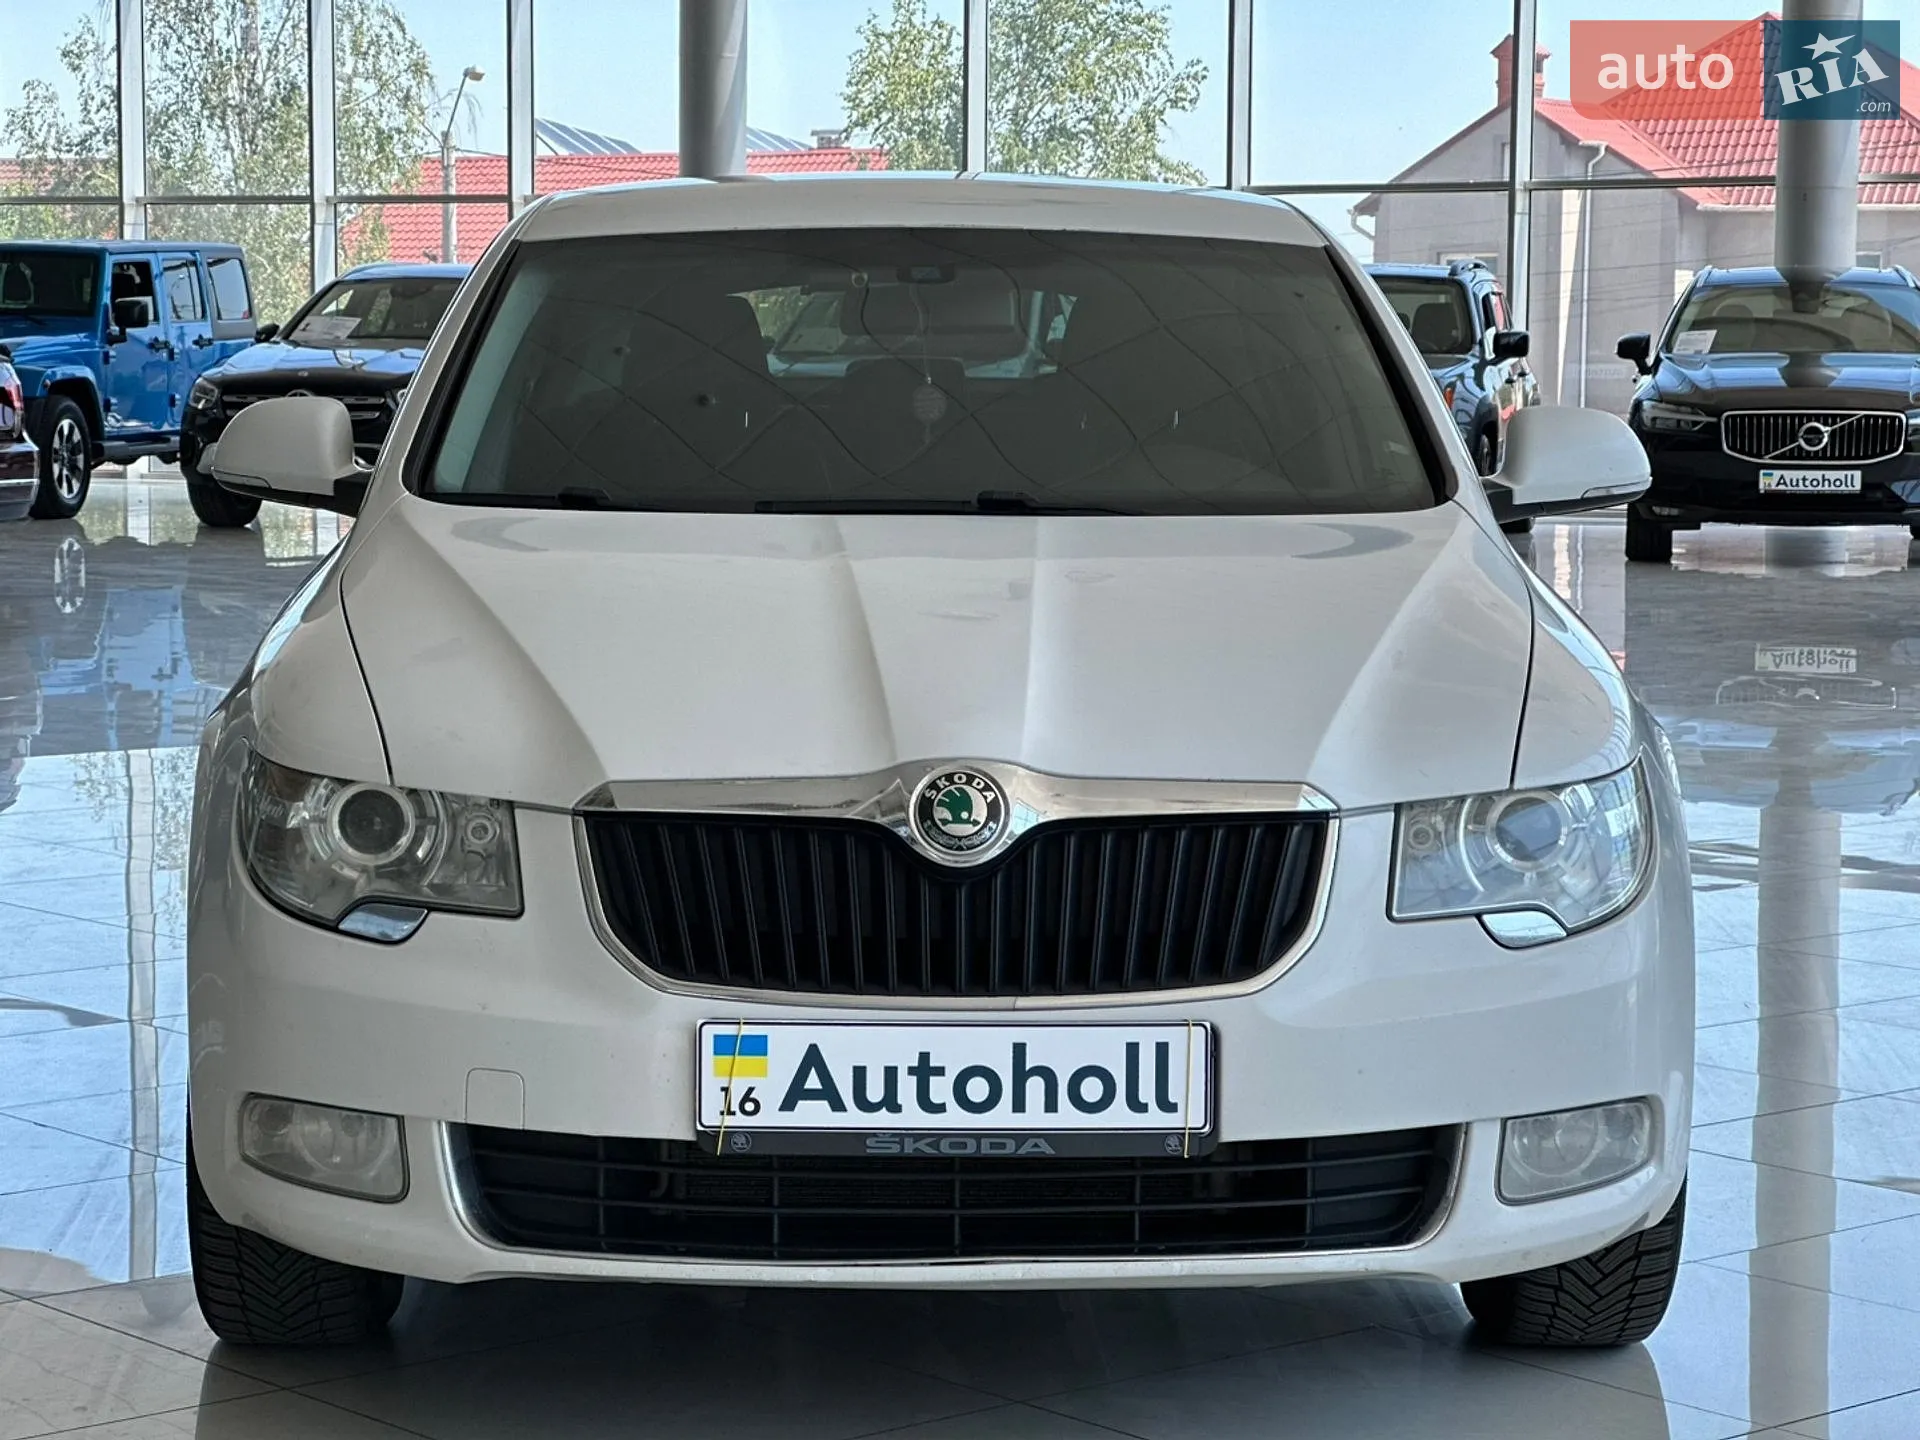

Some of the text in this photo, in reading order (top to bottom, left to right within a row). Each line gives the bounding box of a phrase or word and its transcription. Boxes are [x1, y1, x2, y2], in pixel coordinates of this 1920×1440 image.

[1776, 473, 1856, 488] Autoholl
[778, 1041, 1178, 1115] Autoholl
[720, 1086, 761, 1117] 16
[866, 1133, 1056, 1155] ŠKODA
